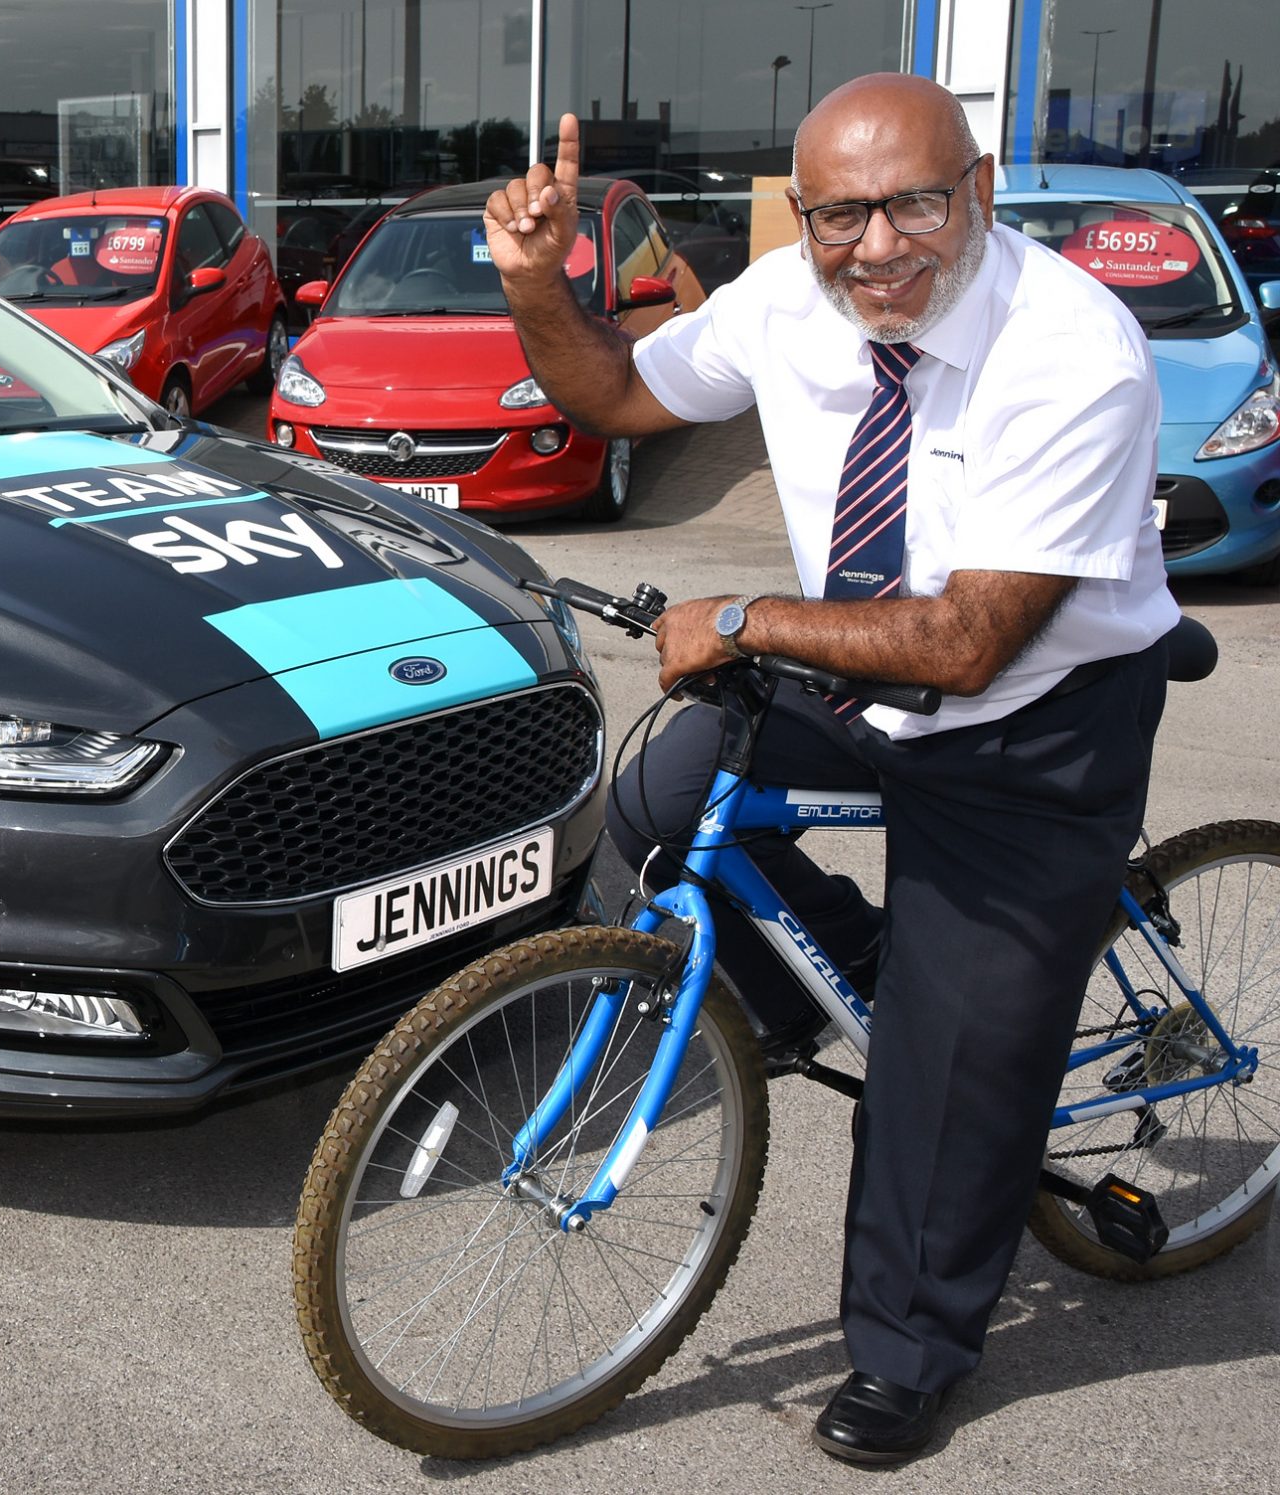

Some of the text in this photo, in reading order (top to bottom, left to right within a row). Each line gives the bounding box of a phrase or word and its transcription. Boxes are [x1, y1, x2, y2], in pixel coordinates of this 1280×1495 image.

[107, 236, 145, 251] £6799
[119, 256, 153, 265] Santander
[1105, 260, 1161, 272] Santander
[1, 470, 243, 513] TEAM
[127, 513, 344, 574] sky
[838, 569, 885, 582] Jennings
[402, 663, 434, 677] Ford
[797, 805, 881, 818] EMULATOR
[356, 840, 541, 955] JENNINGS
[429, 921, 470, 941] JENNINGS FORD
